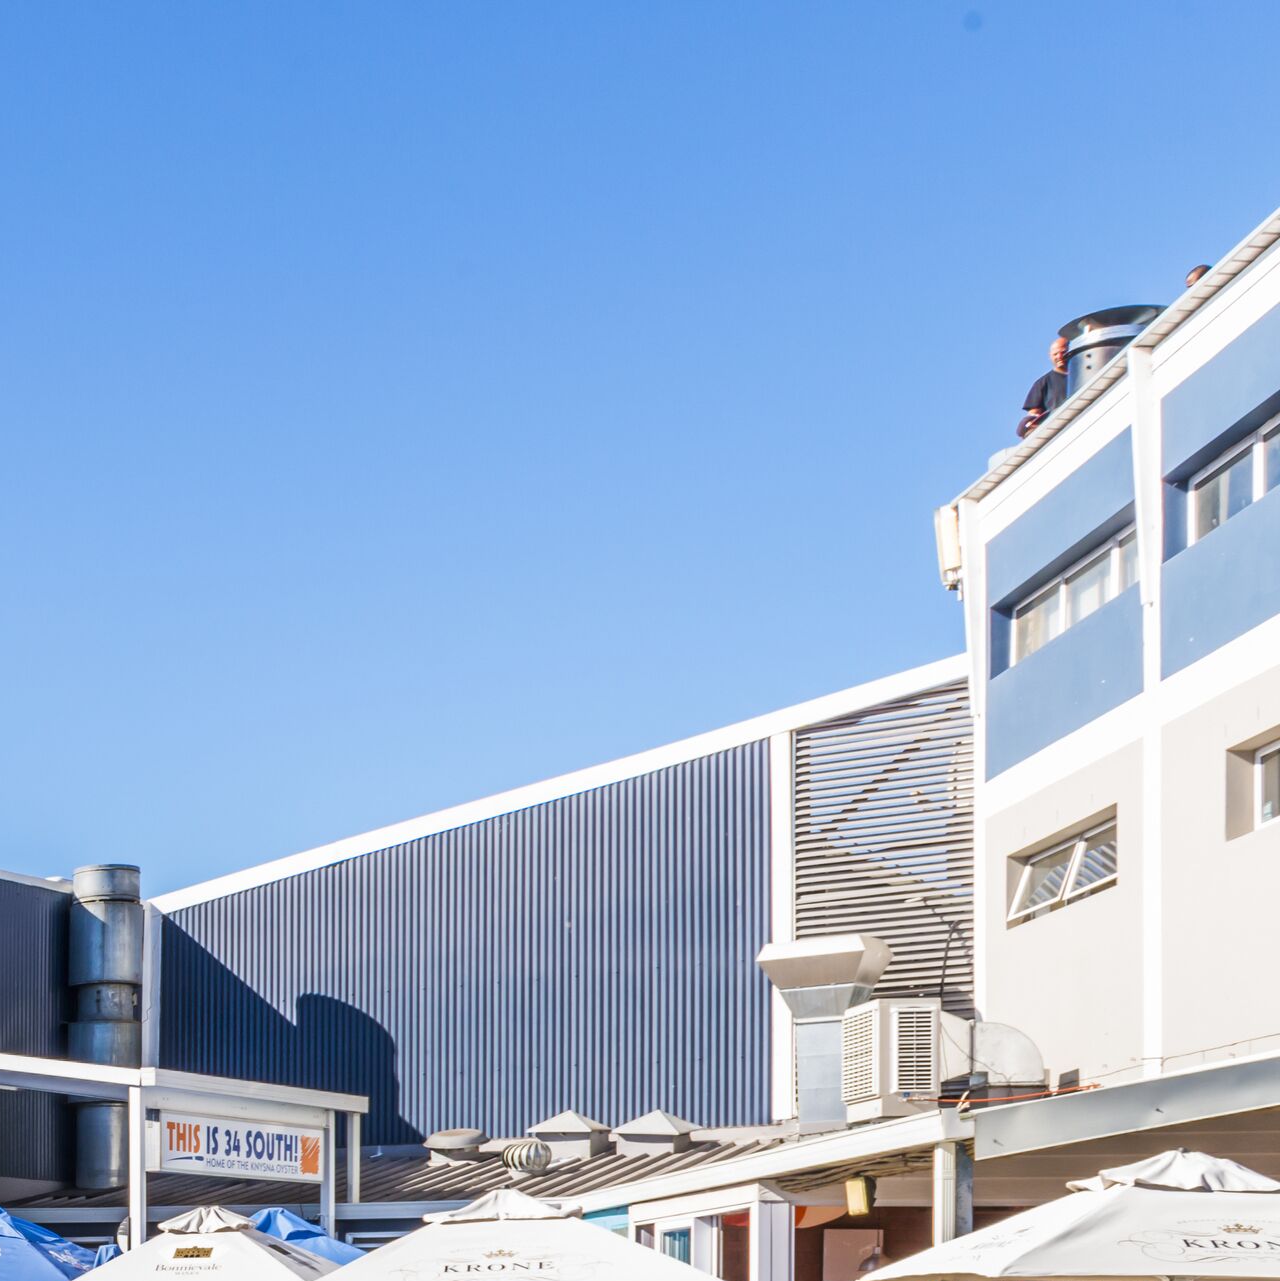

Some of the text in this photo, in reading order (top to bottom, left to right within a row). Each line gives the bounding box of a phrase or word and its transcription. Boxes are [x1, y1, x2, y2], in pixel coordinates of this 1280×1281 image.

[166, 1121, 299, 1163] THIS IS 34 SOUTH!
[206, 1158, 299, 1175] HOME OF THE KNYSNA OYSTER
[443, 1260, 556, 1273] KRONE
